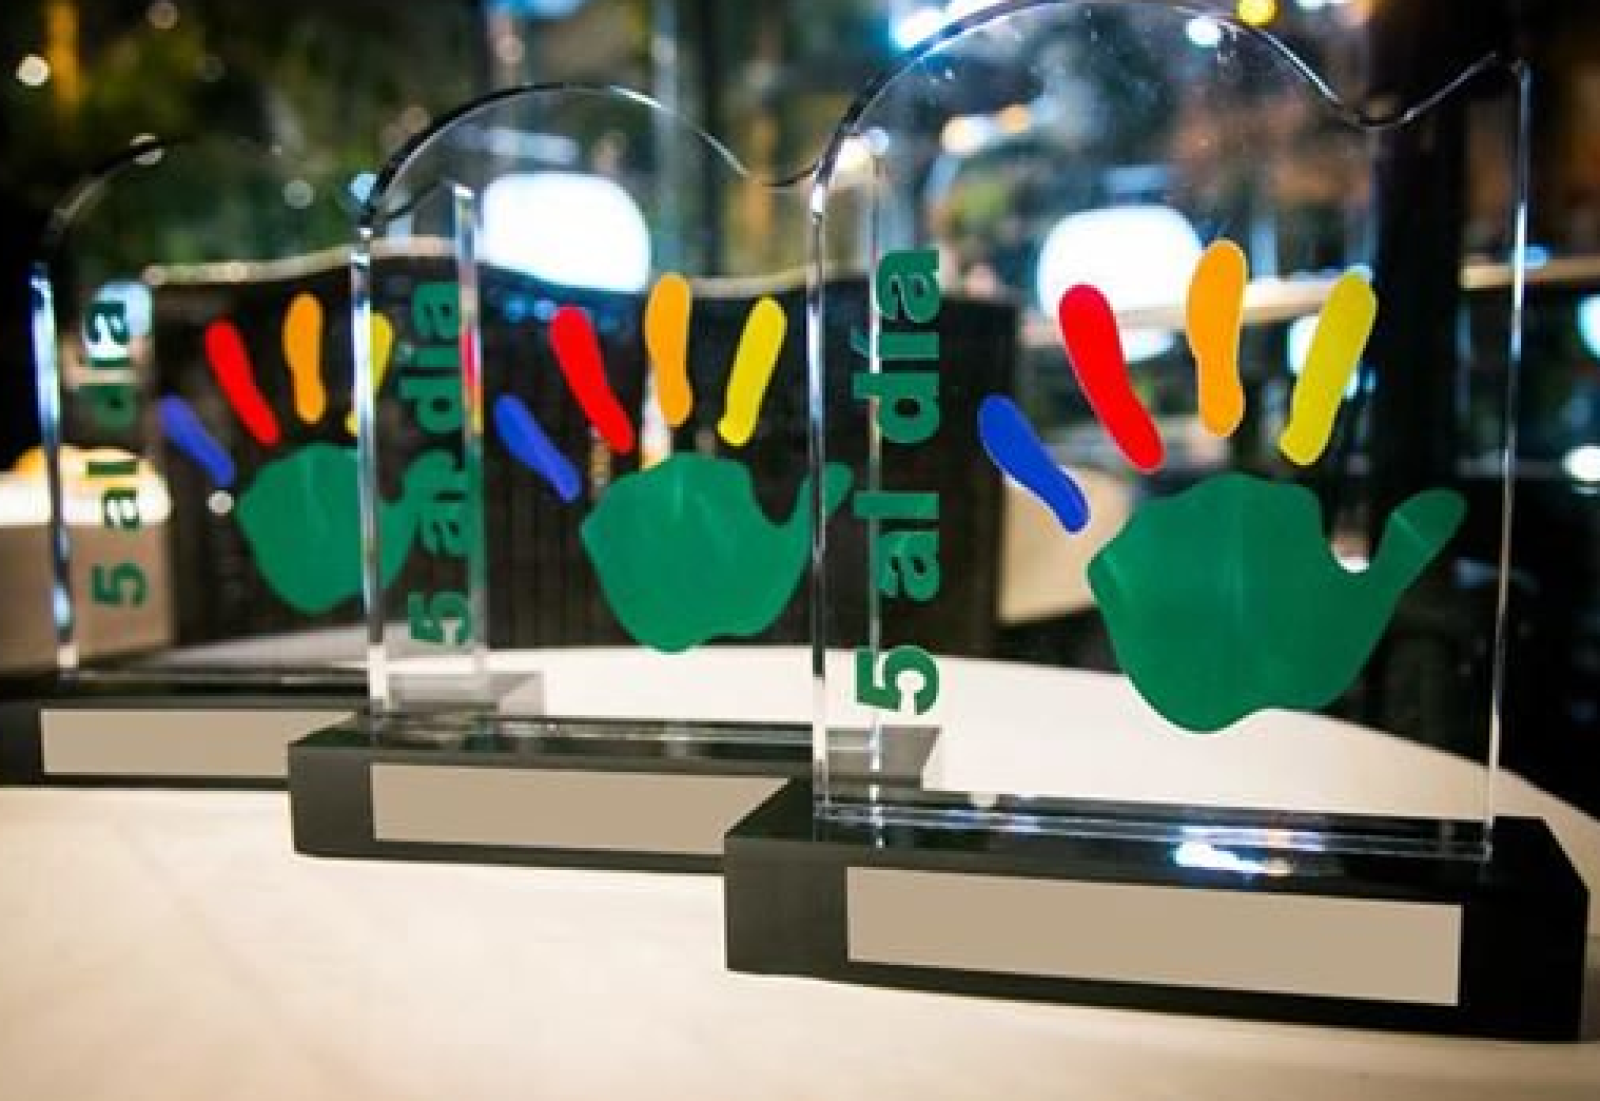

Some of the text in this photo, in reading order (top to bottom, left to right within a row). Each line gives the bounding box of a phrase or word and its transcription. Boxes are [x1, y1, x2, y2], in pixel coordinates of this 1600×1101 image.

[88, 461, 140, 531] al
[850, 249, 940, 715] 5 al día
[92, 563, 147, 608] 5
[408, 591, 470, 645] 5
